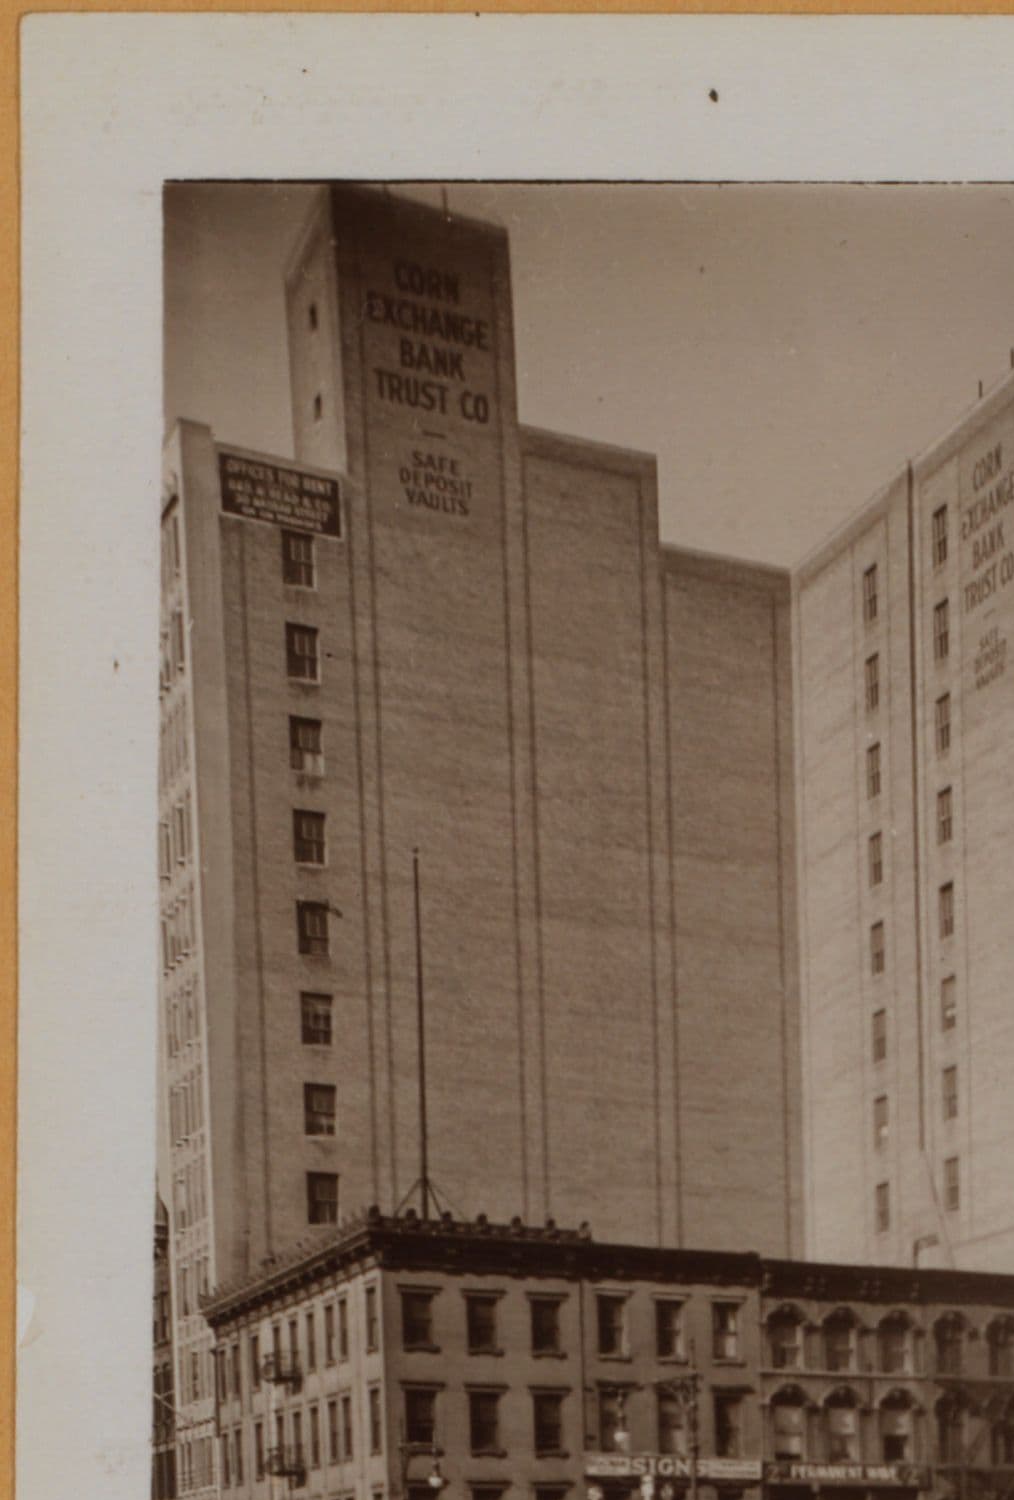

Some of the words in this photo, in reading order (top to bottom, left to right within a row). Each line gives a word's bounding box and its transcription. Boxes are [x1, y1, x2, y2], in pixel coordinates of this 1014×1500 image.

[394, 258, 459, 304] CORN
[367, 290, 488, 351] EXCHANGE
[400, 337, 465, 382] BANK
[373, 367, 448, 415] TRUST
[460, 389, 488, 423] CO
[399, 466, 472, 500] DEPOSIT
[412, 451, 460, 476] SAFE
[973, 442, 1002, 492] CORN
[303, 477, 332, 496] RENT
[405, 487, 470, 516] VAULTS
[973, 520, 1004, 570] BANK
[964, 563, 997, 614] TRUST
[631, 1458, 707, 1476] SIGNS
[790, 1463, 862, 1479] PERMANENT
